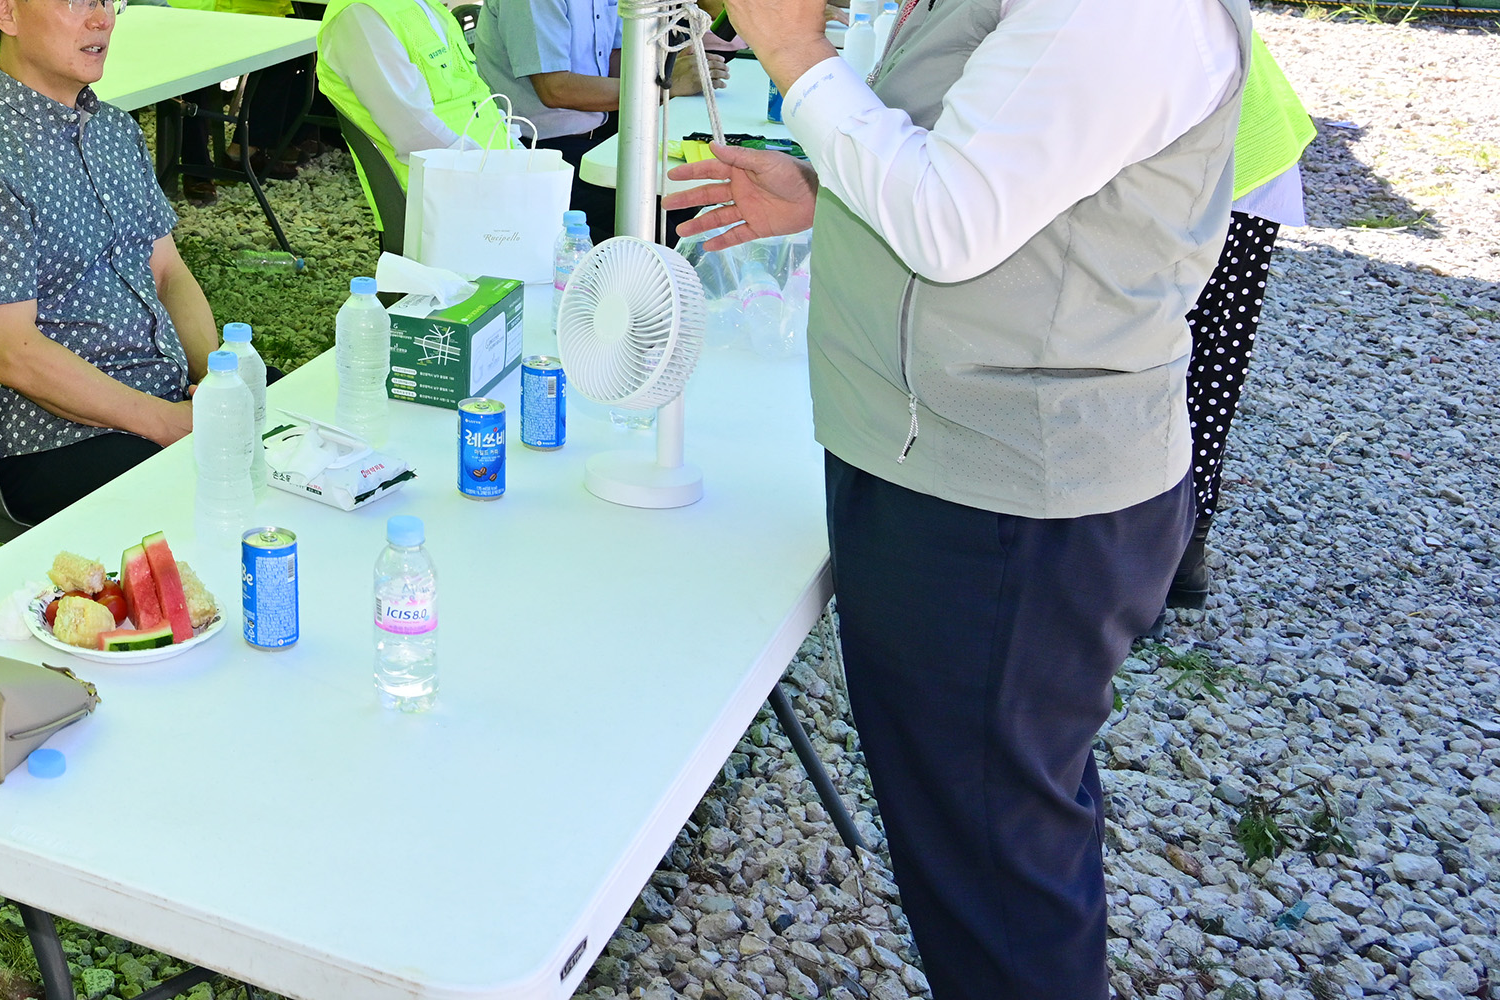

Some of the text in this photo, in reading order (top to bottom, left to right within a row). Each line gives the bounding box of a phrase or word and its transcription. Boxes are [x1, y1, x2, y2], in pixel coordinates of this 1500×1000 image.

[464, 428, 505, 448] 레쓰비
[386, 606, 427, 620] ICIS 8.0
